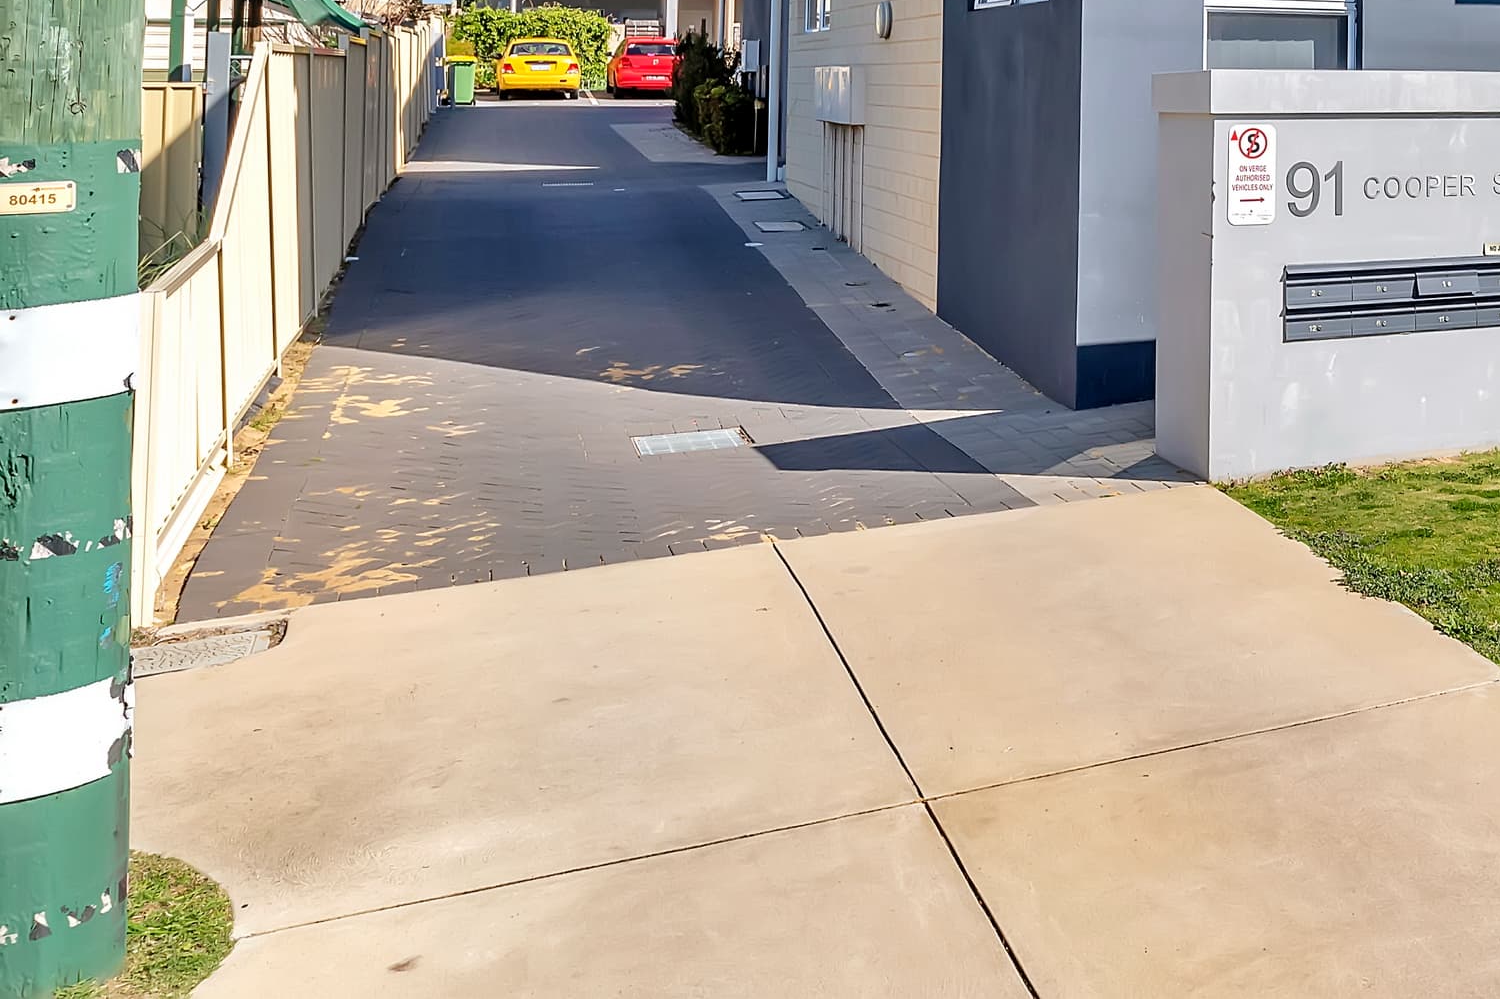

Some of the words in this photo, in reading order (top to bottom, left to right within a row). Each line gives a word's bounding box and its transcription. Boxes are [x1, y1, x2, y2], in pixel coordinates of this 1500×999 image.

[1239, 165, 1248, 173] ON
[1248, 164, 1267, 173] VERGE
[1235, 174, 1270, 182] AUTHORISED
[1231, 183, 1258, 192] VEHICLES
[1258, 183, 1274, 191] ONLY
[1285, 160, 1343, 218] 91
[1362, 174, 1477, 199] COOPER
[9, 193, 57, 206] 80415
